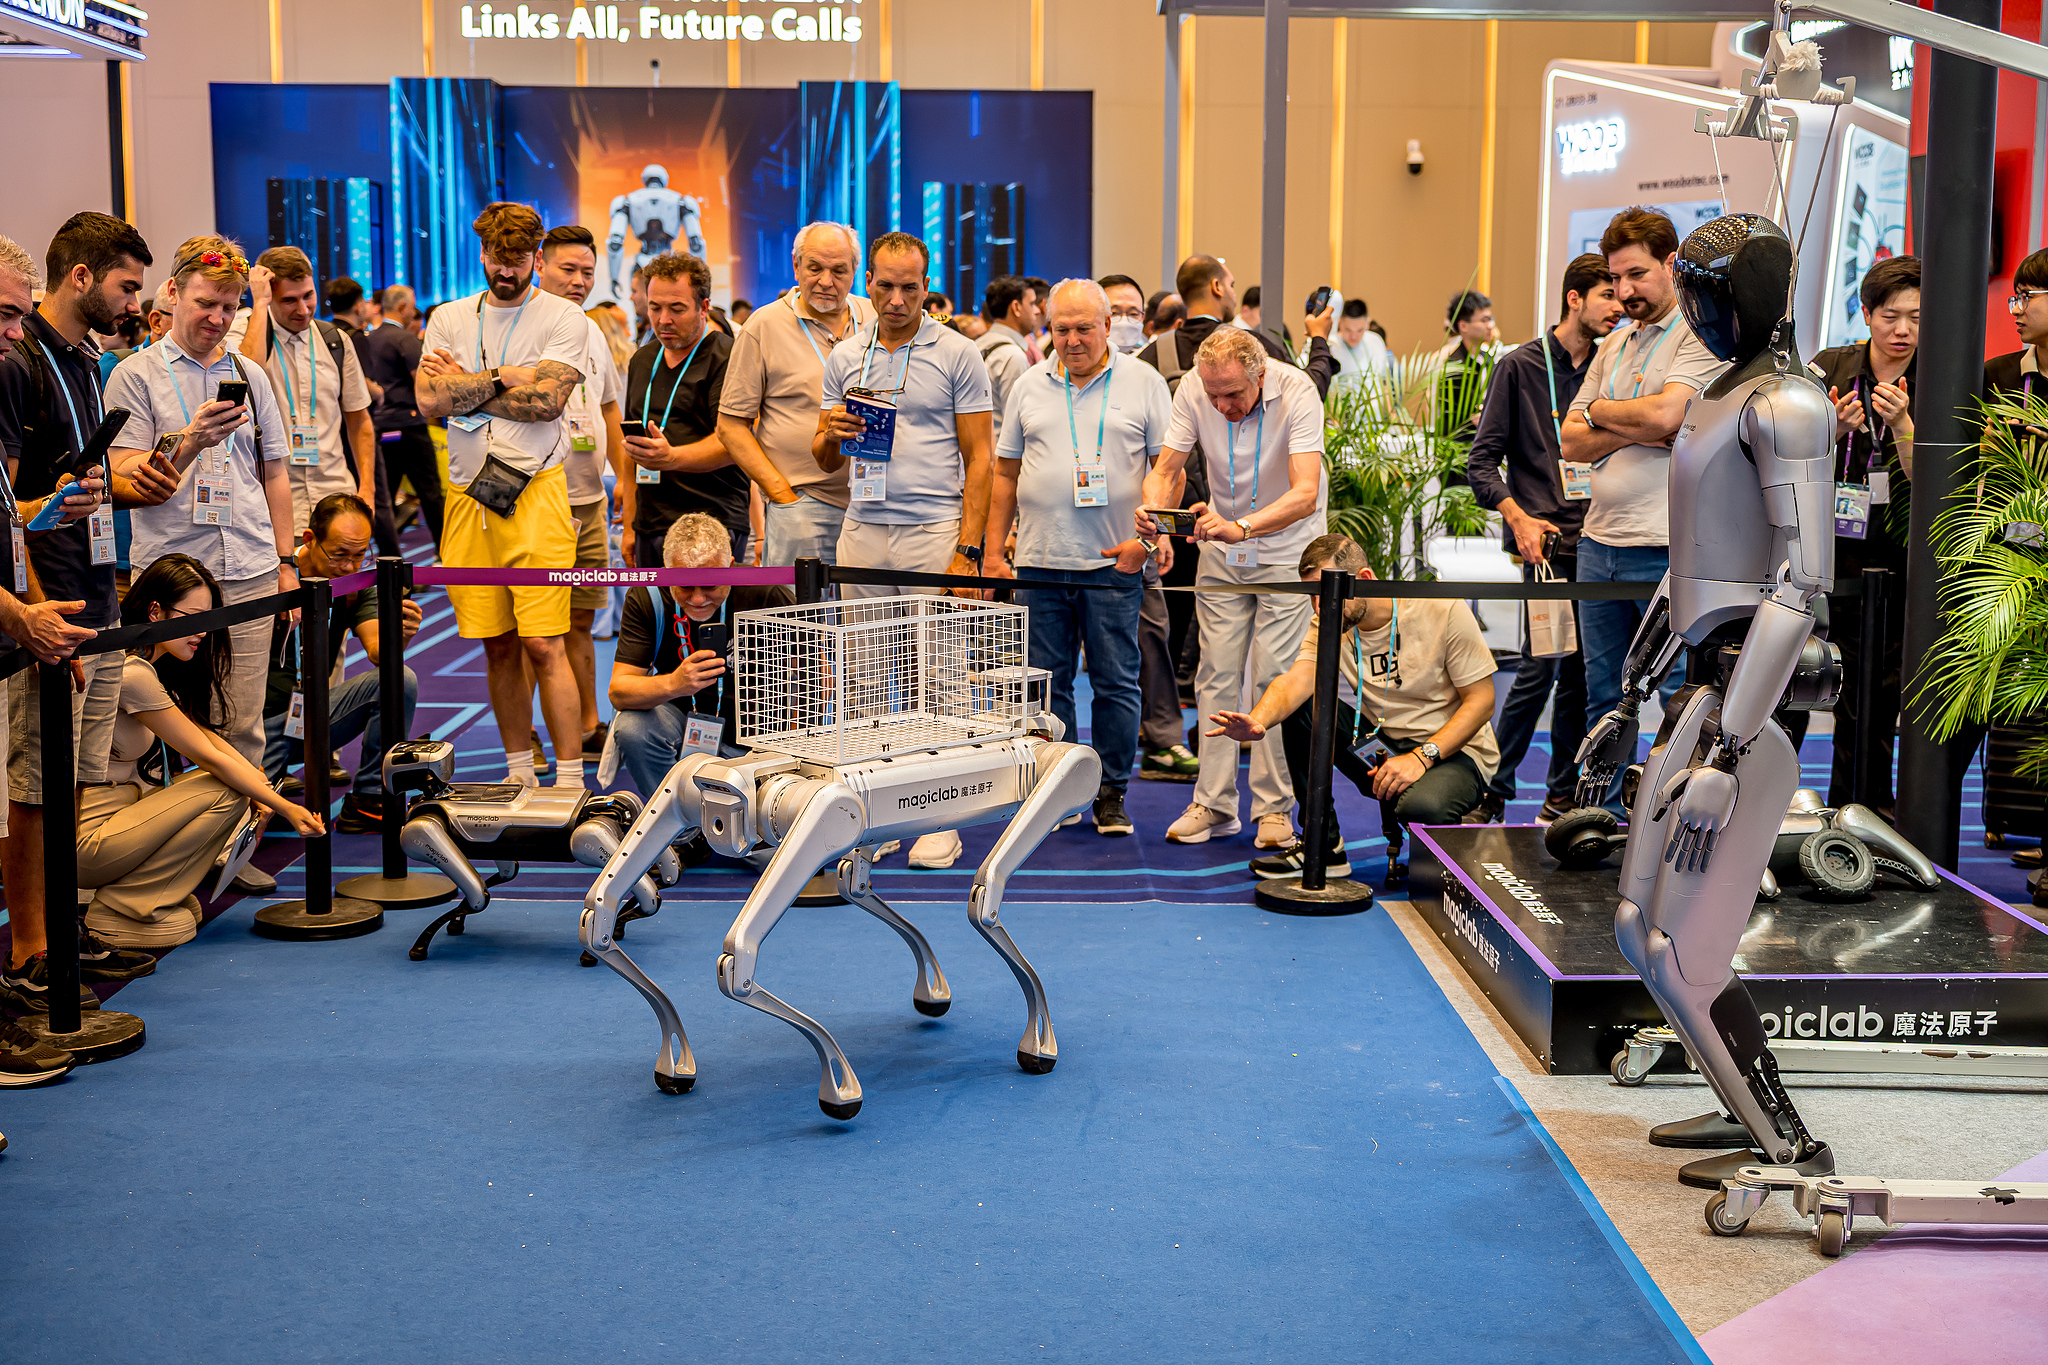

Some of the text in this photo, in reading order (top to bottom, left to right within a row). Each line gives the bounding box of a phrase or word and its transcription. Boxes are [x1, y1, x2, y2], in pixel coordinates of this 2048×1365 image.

[461, 4, 863, 43] Links All, Future Calls
[549, 569, 658, 586] magiclab 魔法原子
[898, 781, 993, 810] magiclab 魔法原子
[1481, 862, 1541, 900] magiclab
[1443, 891, 1478, 949] magiclab
[1891, 1011, 1998, 1037] 魔法原子
